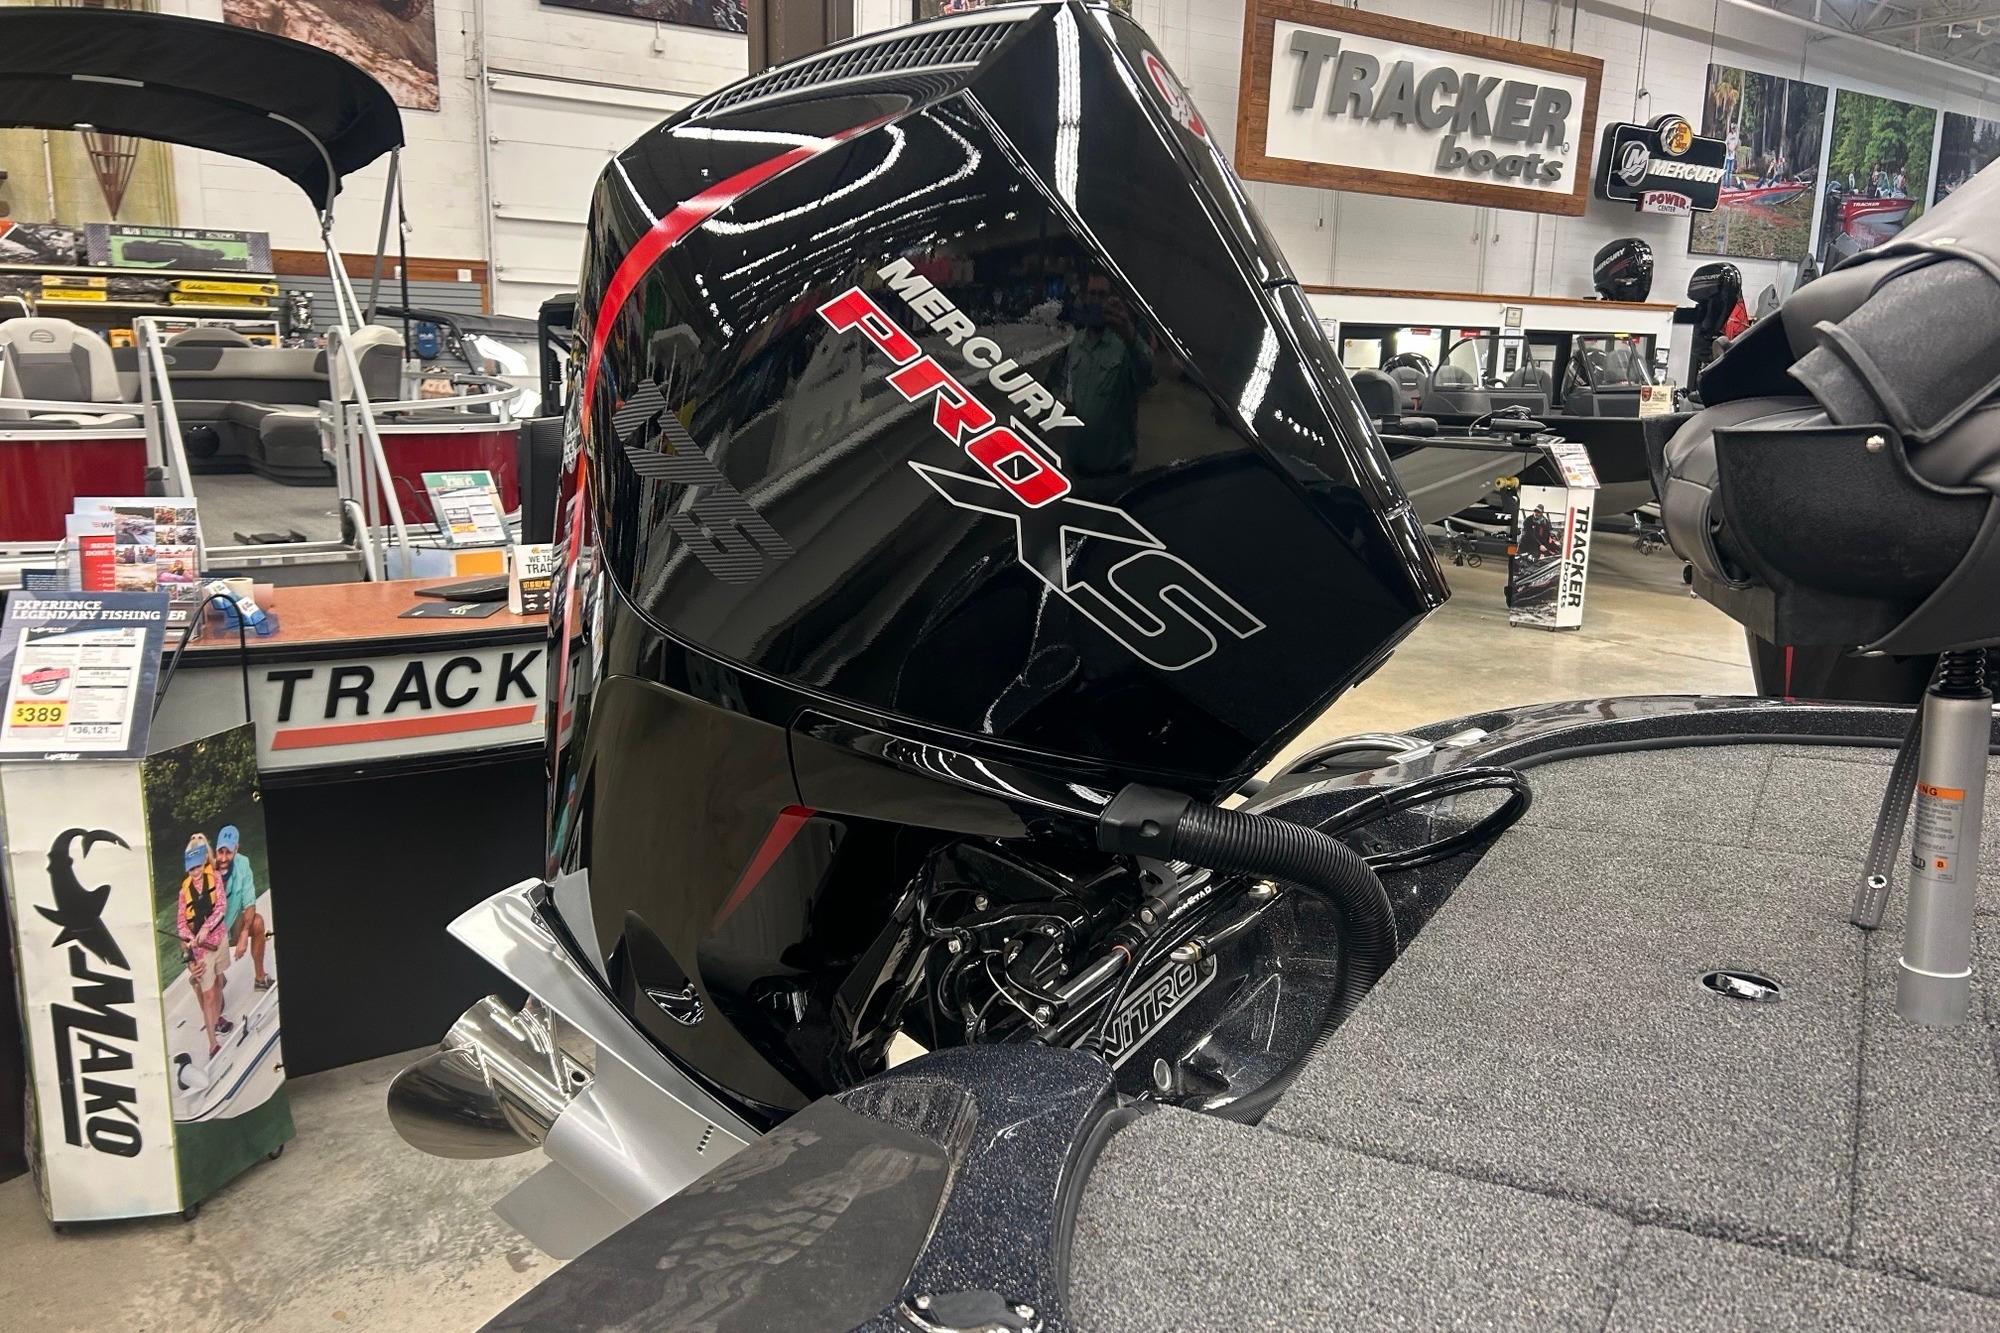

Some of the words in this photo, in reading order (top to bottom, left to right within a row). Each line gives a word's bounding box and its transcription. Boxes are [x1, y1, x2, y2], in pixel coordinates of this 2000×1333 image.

[1290, 29, 1572, 147] TRACKER
[1437, 134, 1563, 183] boats
[1650, 159, 1727, 184] MERCURY
[1648, 193, 1687, 210] POWER
[1657, 204, 1676, 213] CENTER
[1594, 247, 1626, 274] MERCURY
[877, 256, 1085, 433] MERCURY
[816, 285, 1072, 508] PRO
[528, 555, 540, 563] WE
[908, 415, 1266, 670] XS
[1568, 506, 1590, 608] TRACKER
[13, 600, 102, 610] EXPERIENCE
[1560, 562, 1570, 609] boats
[11, 610, 98, 620] LEGENDARY
[100, 610, 161, 620] FISHING
[266, 649, 543, 722] TRACK
[16, 707, 62, 722] $389
[1103, 963, 1198, 1058] NITRO
[51, 944, 142, 1158] MAKO
